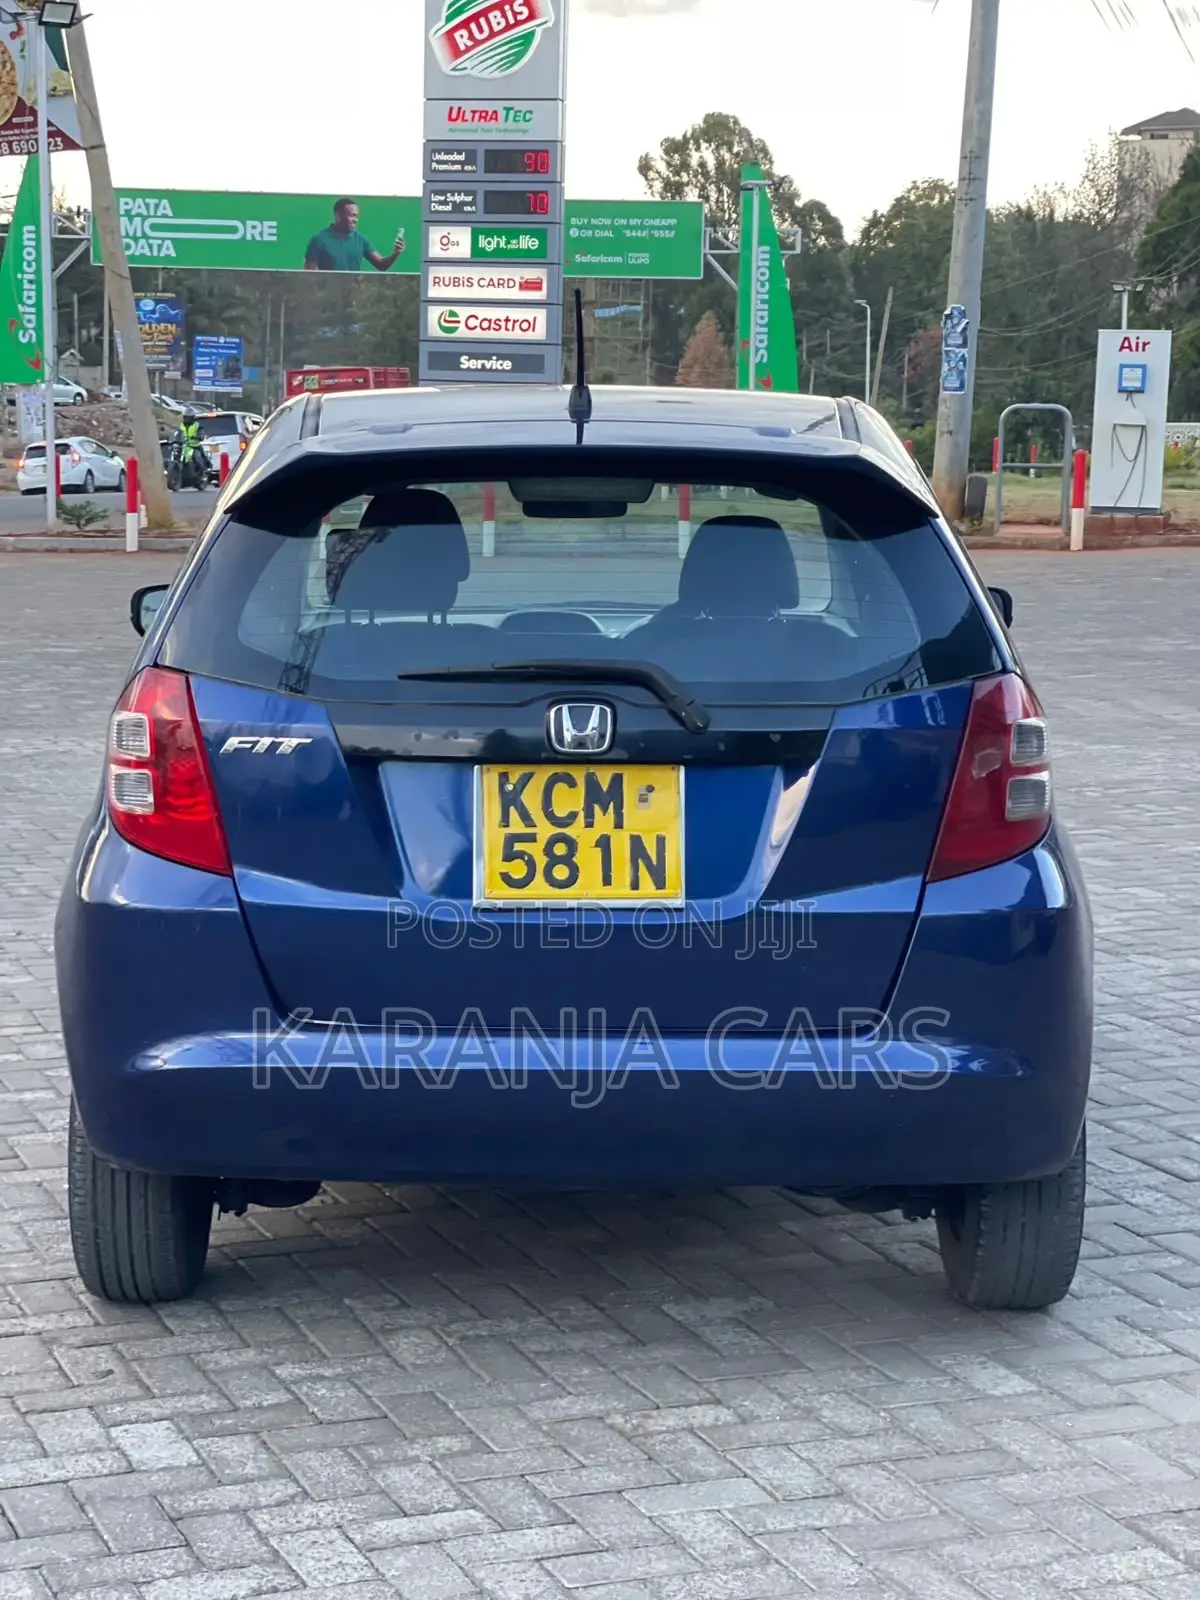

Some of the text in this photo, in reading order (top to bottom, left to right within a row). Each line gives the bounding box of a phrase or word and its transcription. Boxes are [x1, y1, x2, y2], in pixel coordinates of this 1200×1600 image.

[0, 142, 10, 155] 8
[431, 151, 466, 161] Unleaded
[431, 161, 462, 171] Premium
[431, 193, 446, 201] Low
[446, 192, 474, 204] Sulphur
[119, 197, 174, 217] PATA
[431, 202, 453, 212] Diesel
[570, 217, 589, 226] BUY
[590, 218, 612, 226] NOW
[613, 218, 627, 227] ON
[628, 218, 642, 227] MY
[579, 229, 593, 238] OR
[594, 229, 615, 238] DIAL
[123, 238, 177, 257] DATA
[478, 234, 507, 251] light
[519, 234, 540, 250] life
[575, 253, 623, 263] Safaricom
[17, 225, 37, 344] Safaricom
[477, 277, 517, 289] CARD
[464, 314, 537, 333] Castrol
[1118, 336, 1151, 352] Air
[460, 355, 513, 371] Service
[219, 737, 313, 755] FIT
[498, 771, 625, 829] KCM
[498, 832, 667, 891] 581N
